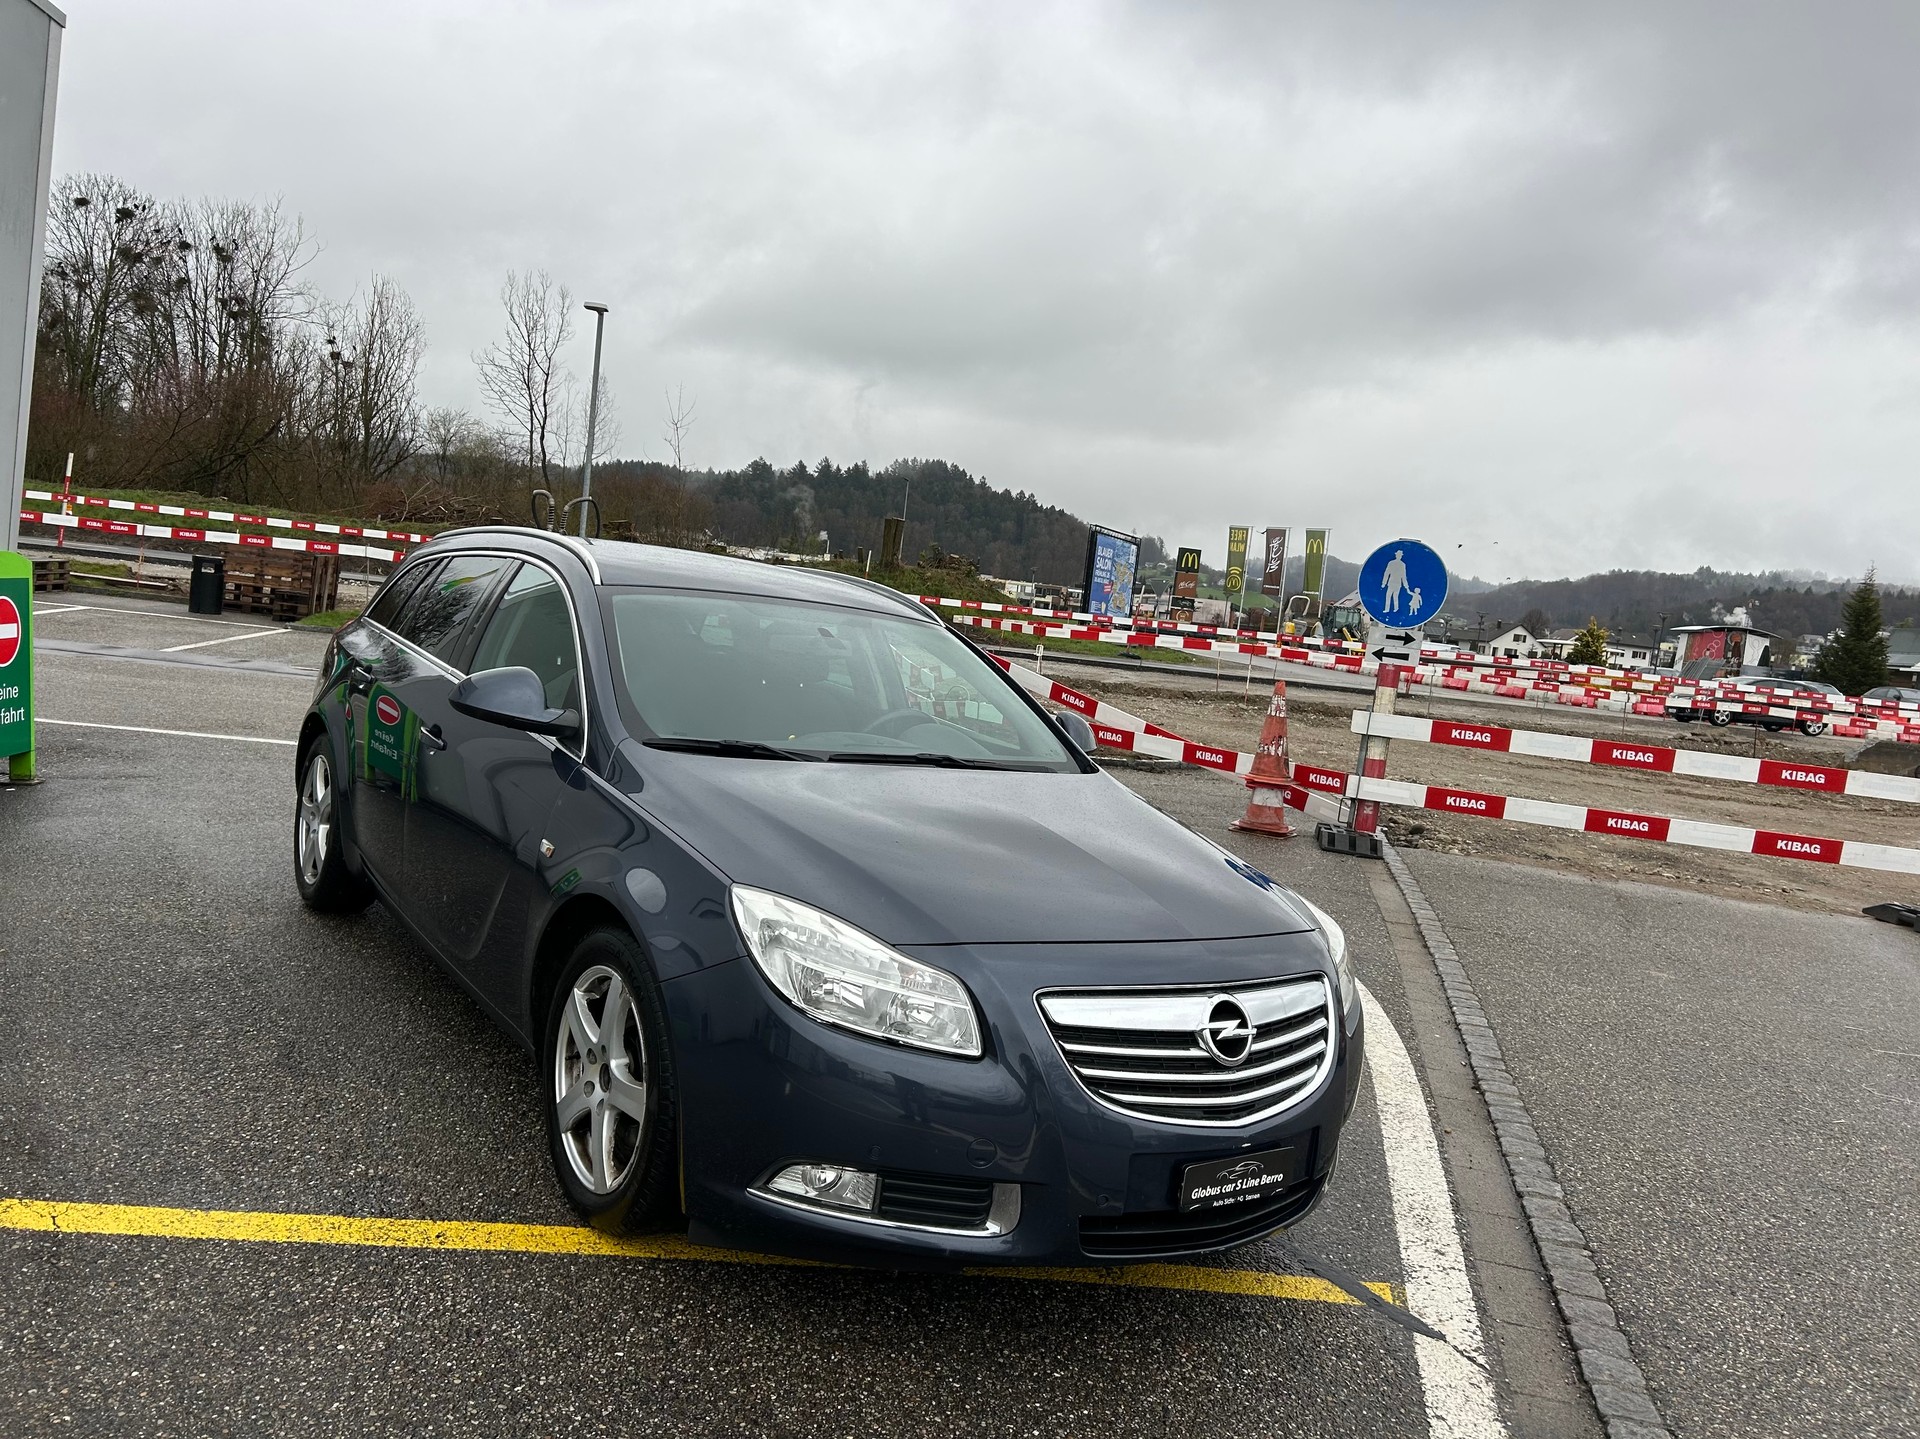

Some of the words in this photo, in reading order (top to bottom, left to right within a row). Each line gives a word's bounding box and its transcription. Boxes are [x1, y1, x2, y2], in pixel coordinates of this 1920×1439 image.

[1098, 546, 1113, 559] BLAUER
[1096, 556, 1111, 570] SALON
[1061, 692, 1085, 709] KIBAG
[0, 707, 24, 724] fahrt
[1098, 730, 1122, 742] KIBAG
[1452, 729, 1491, 742] KIBAG
[1196, 751, 1223, 763] KIBAG
[1612, 749, 1653, 762] KIBAG
[1309, 773, 1340, 787] KIBAG
[1782, 770, 1825, 784] KIBAG
[1446, 796, 1486, 810] KIBAG
[1608, 818, 1649, 831] KIBAG
[1777, 840, 1820, 854] KIBAG
[1192, 1185, 1221, 1199] Globus
[1222, 1183, 1235, 1193] car
[1236, 1180, 1242, 1190] S
[1242, 1178, 1259, 1189] Line
[1261, 1174, 1283, 1184] Berro
